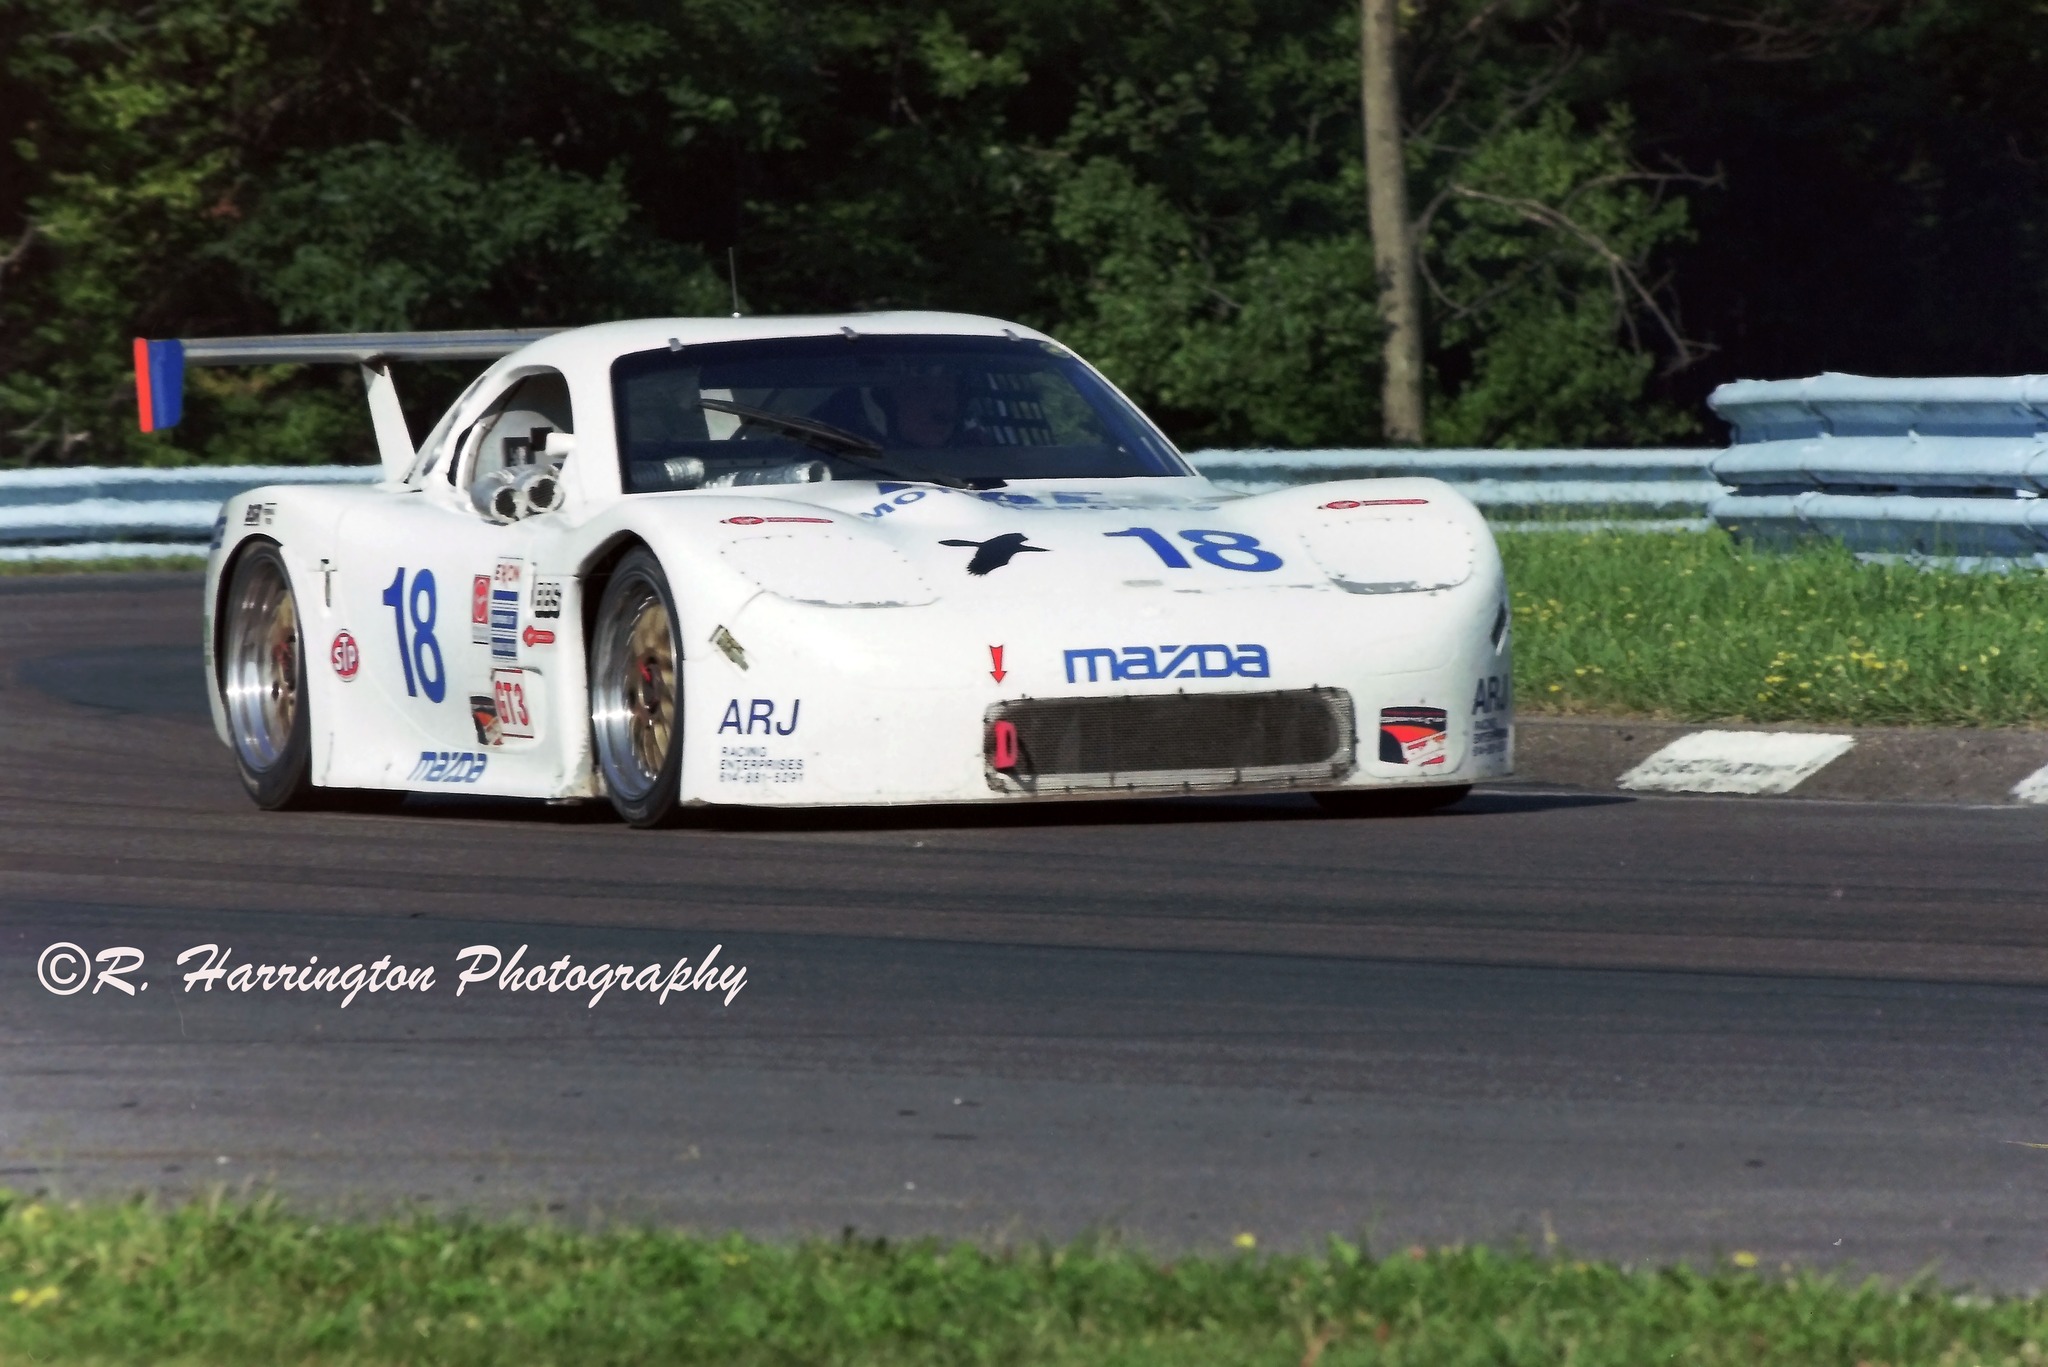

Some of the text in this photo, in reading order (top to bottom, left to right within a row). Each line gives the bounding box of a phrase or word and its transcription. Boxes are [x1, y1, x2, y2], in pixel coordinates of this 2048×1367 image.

[1103, 527, 1284, 572] 18
[333, 636, 356, 671] STP
[383, 566, 446, 703] 18
[495, 680, 530, 726] GT3
[1472, 674, 1509, 716] ARJ
[717, 698, 800, 736] ARJ
